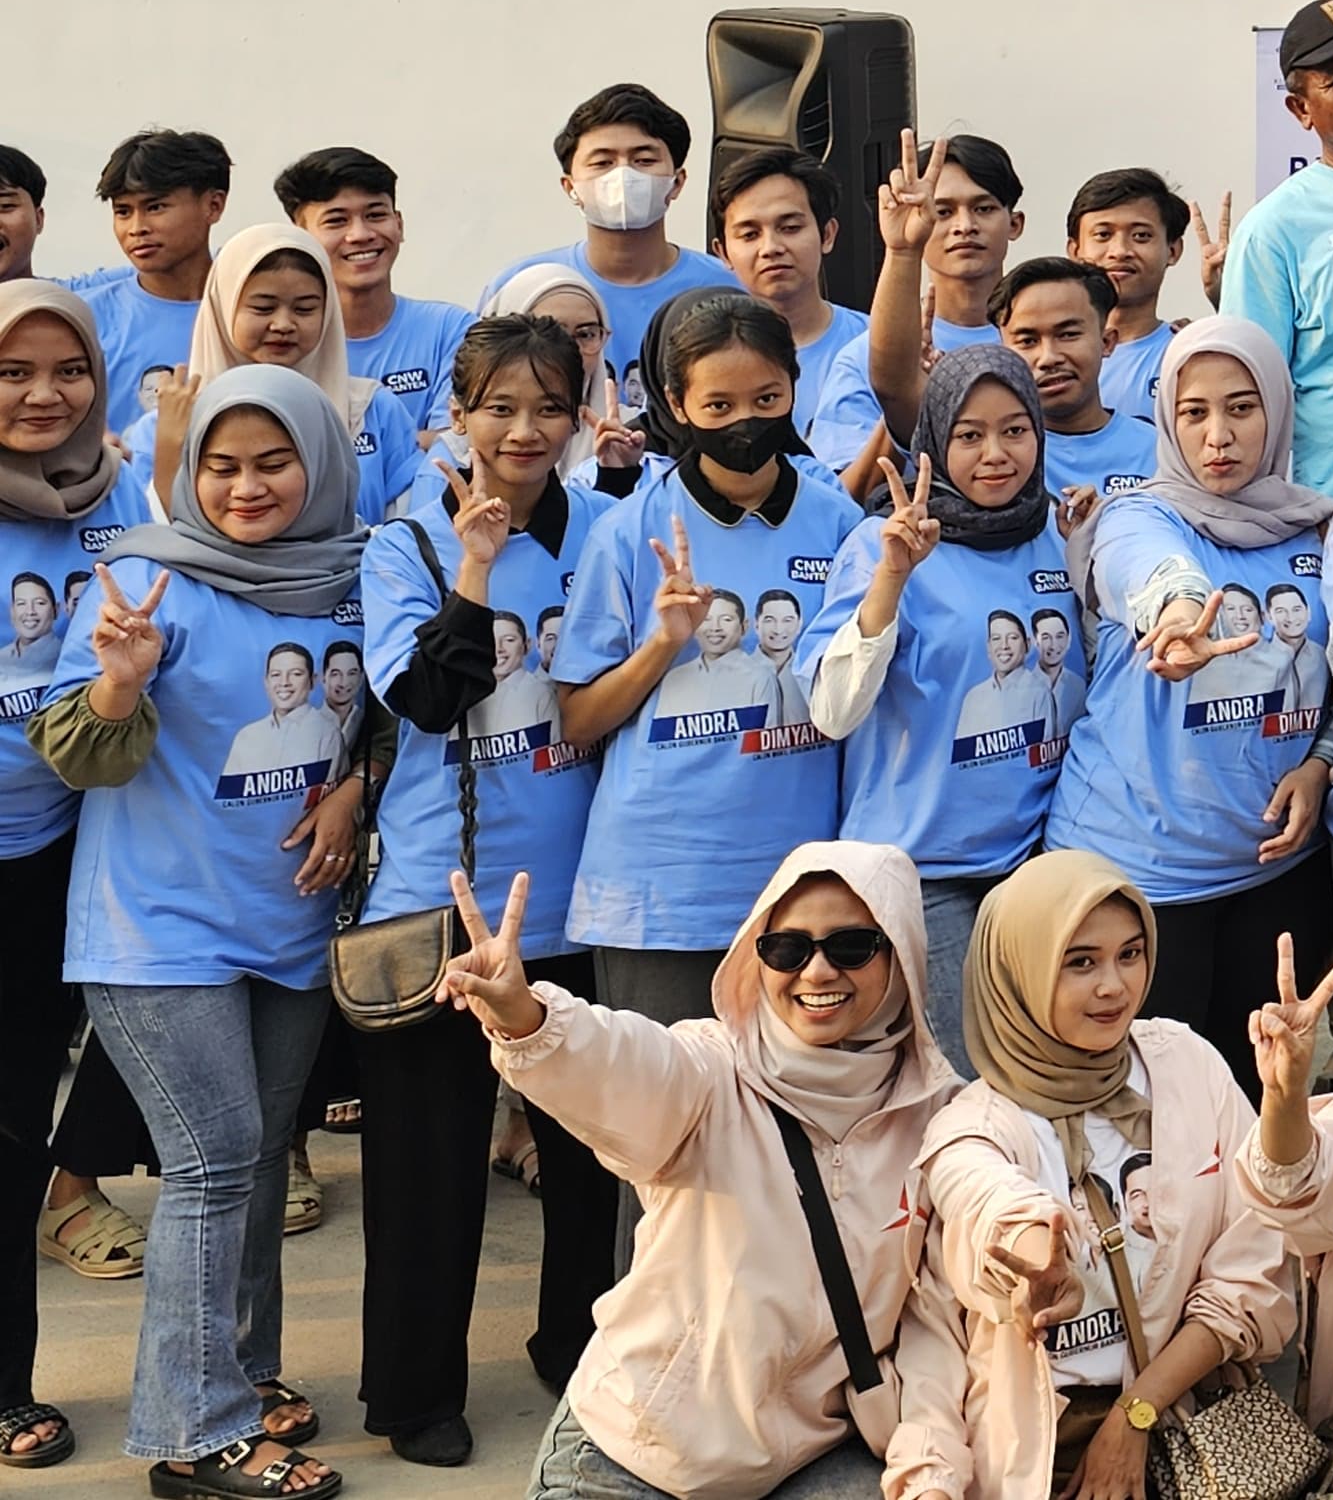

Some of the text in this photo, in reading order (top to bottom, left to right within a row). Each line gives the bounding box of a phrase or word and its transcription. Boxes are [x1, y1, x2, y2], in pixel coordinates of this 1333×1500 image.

[387, 370, 424, 386] CNW
[791, 570, 827, 581] BANTE
[793, 558, 832, 573] CNW
[1205, 696, 1265, 724] ANDRA
[674, 710, 740, 739] ANDRA
[471, 730, 530, 761] ANDRA
[975, 726, 1027, 758] ANDRA
[242, 766, 307, 798] ANDRA
